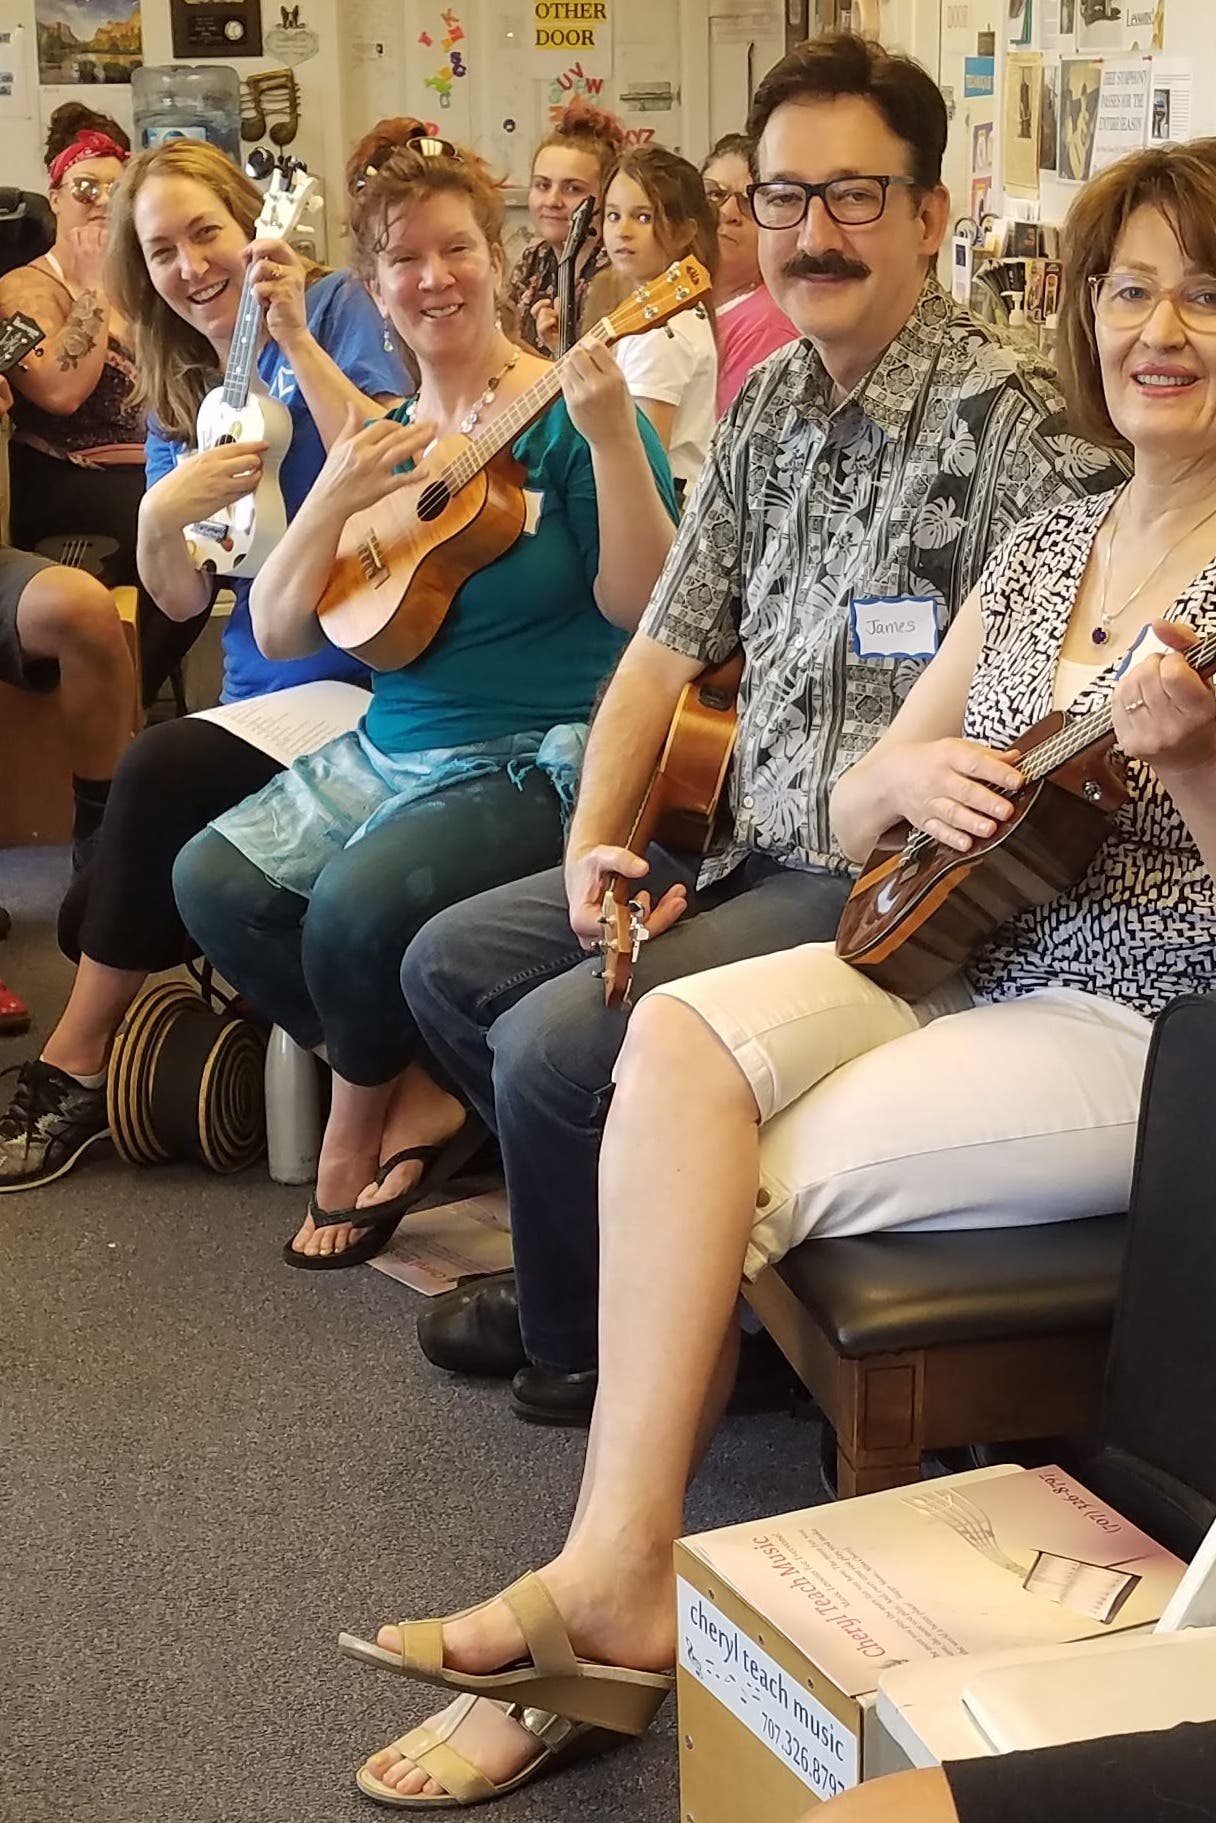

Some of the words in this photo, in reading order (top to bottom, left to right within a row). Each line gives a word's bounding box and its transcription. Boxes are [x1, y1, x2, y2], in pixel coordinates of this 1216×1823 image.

[535, 2, 606, 20] OTHER
[536, 30, 595, 46] DOOR
[866, 619, 916, 636] James
[1083, 1511, 1121, 1533] (707)
[753, 1535, 798, 1577] Music
[790, 1576, 839, 1616] Teach
[825, 1614, 886, 1658] Cheryl
[690, 1600, 738, 1663] cheryl
[743, 1650, 788, 1709] teach
[794, 1698, 844, 1762] music
